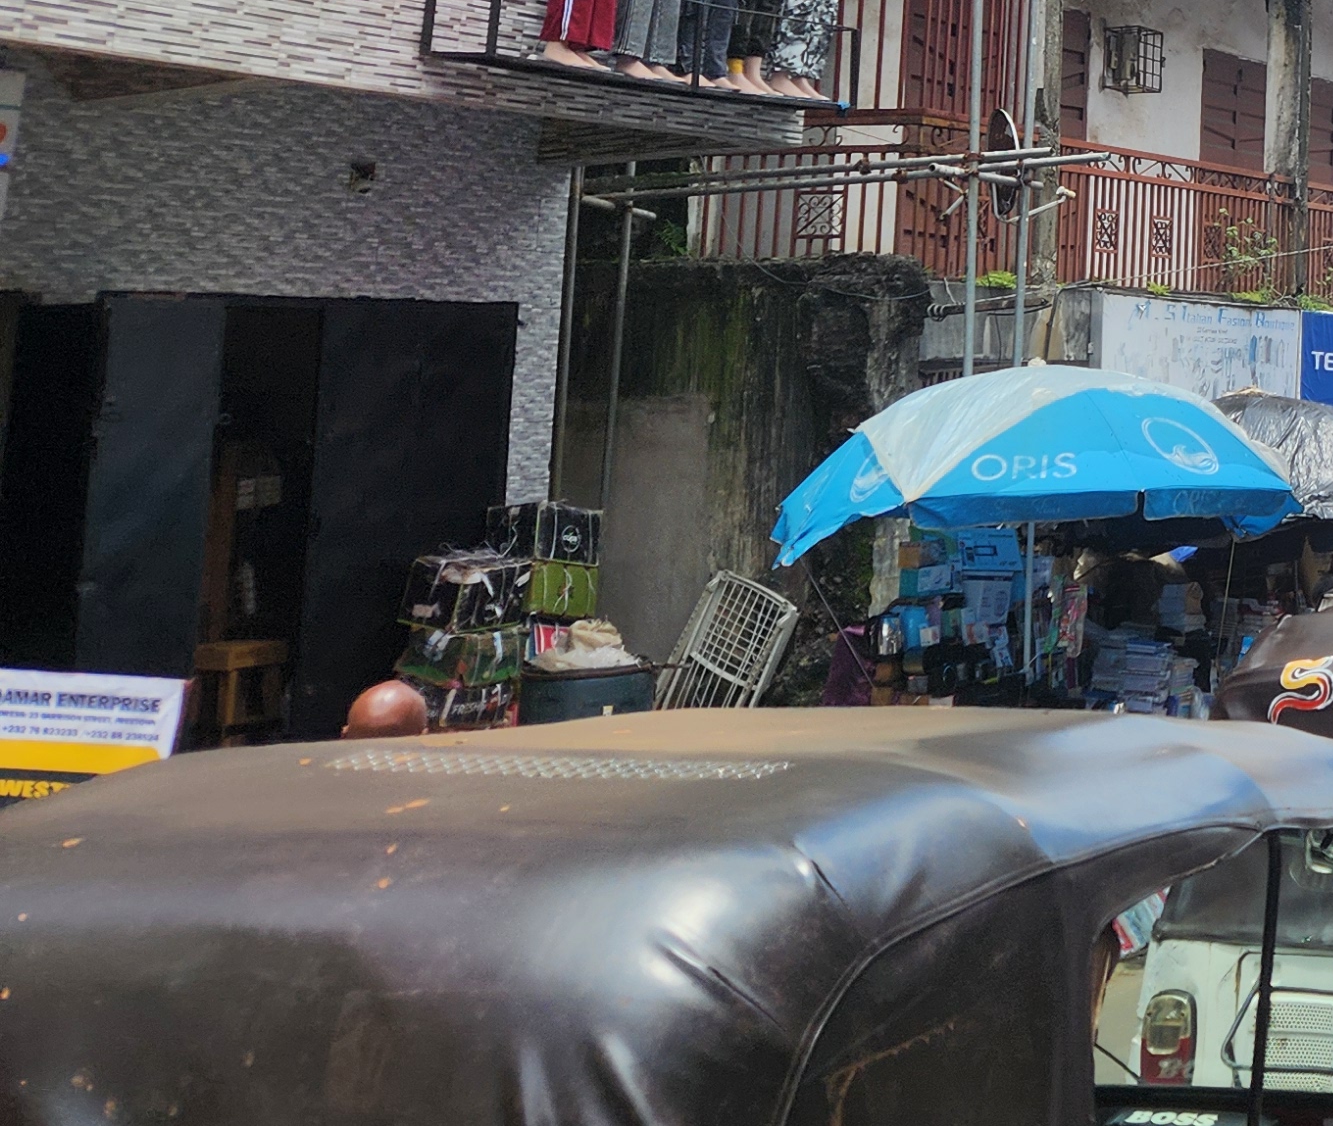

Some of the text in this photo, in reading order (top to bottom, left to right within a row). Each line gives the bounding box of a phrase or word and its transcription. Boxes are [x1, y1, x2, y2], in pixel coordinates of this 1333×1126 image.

[970, 452, 1078, 481] ORIS
[0, 688, 161, 713] AMAR ENTERPRISE
[1124, 1110, 1219, 1126] BOSS
